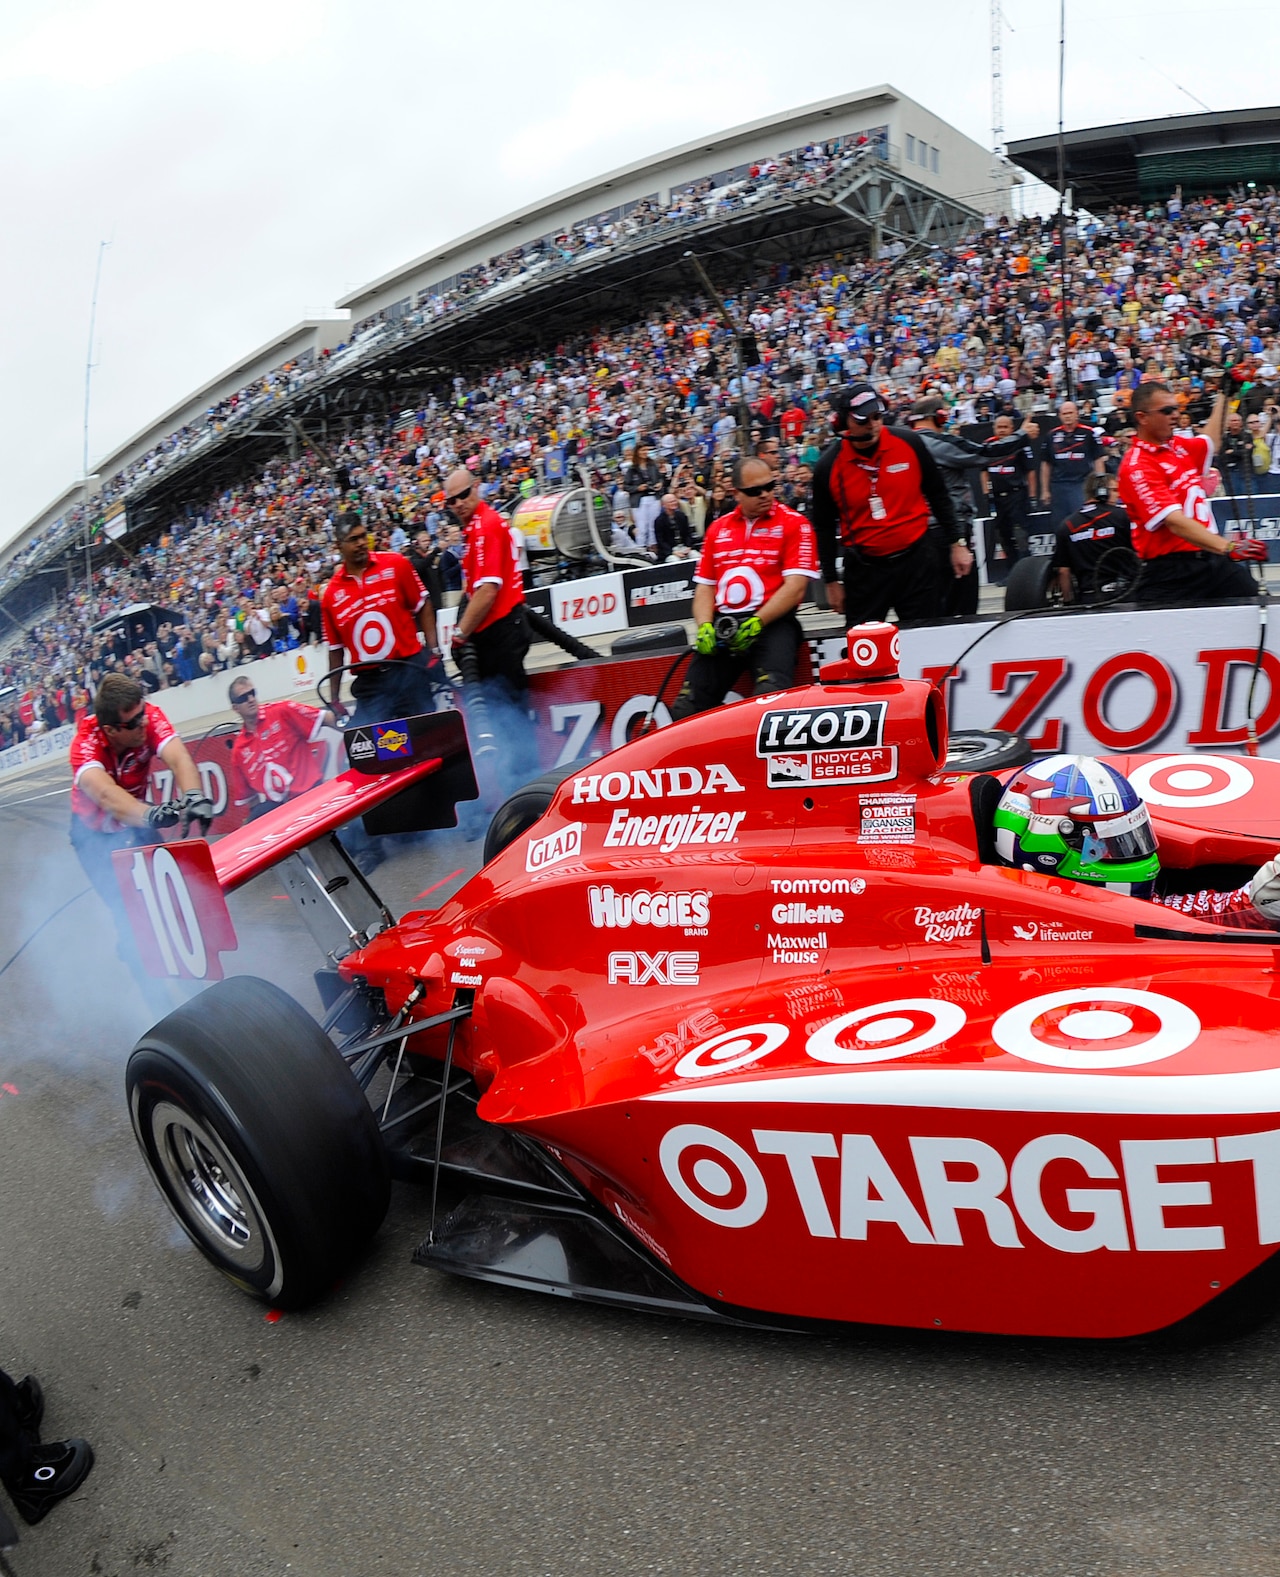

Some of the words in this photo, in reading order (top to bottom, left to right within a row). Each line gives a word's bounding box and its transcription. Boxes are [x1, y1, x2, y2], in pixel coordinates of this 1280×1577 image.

[560, 592, 618, 622] IZOD
[765, 709, 872, 746] IZOD
[351, 741, 374, 752] PEAK
[814, 751, 883, 764] INDYCAR
[814, 763, 872, 777] SERIES
[571, 764, 745, 804] HONDA
[859, 797, 917, 805] CHAMPIONS
[872, 806, 913, 817] TARGET
[603, 805, 746, 853] Energizer
[872, 818, 912, 827] GANASSI
[529, 830, 578, 867] GLAD
[132, 846, 207, 978] 10
[771, 903, 845, 925] Gillette
[914, 902, 982, 926] Breathe
[684, 928, 709, 936] BRAND
[924, 921, 976, 942] Right
[1040, 929, 1093, 941] lifewater
[767, 932, 828, 949] Maxwell
[772, 949, 819, 964] House
[608, 951, 700, 986] AXE
[451, 972, 482, 985] Microsoft
